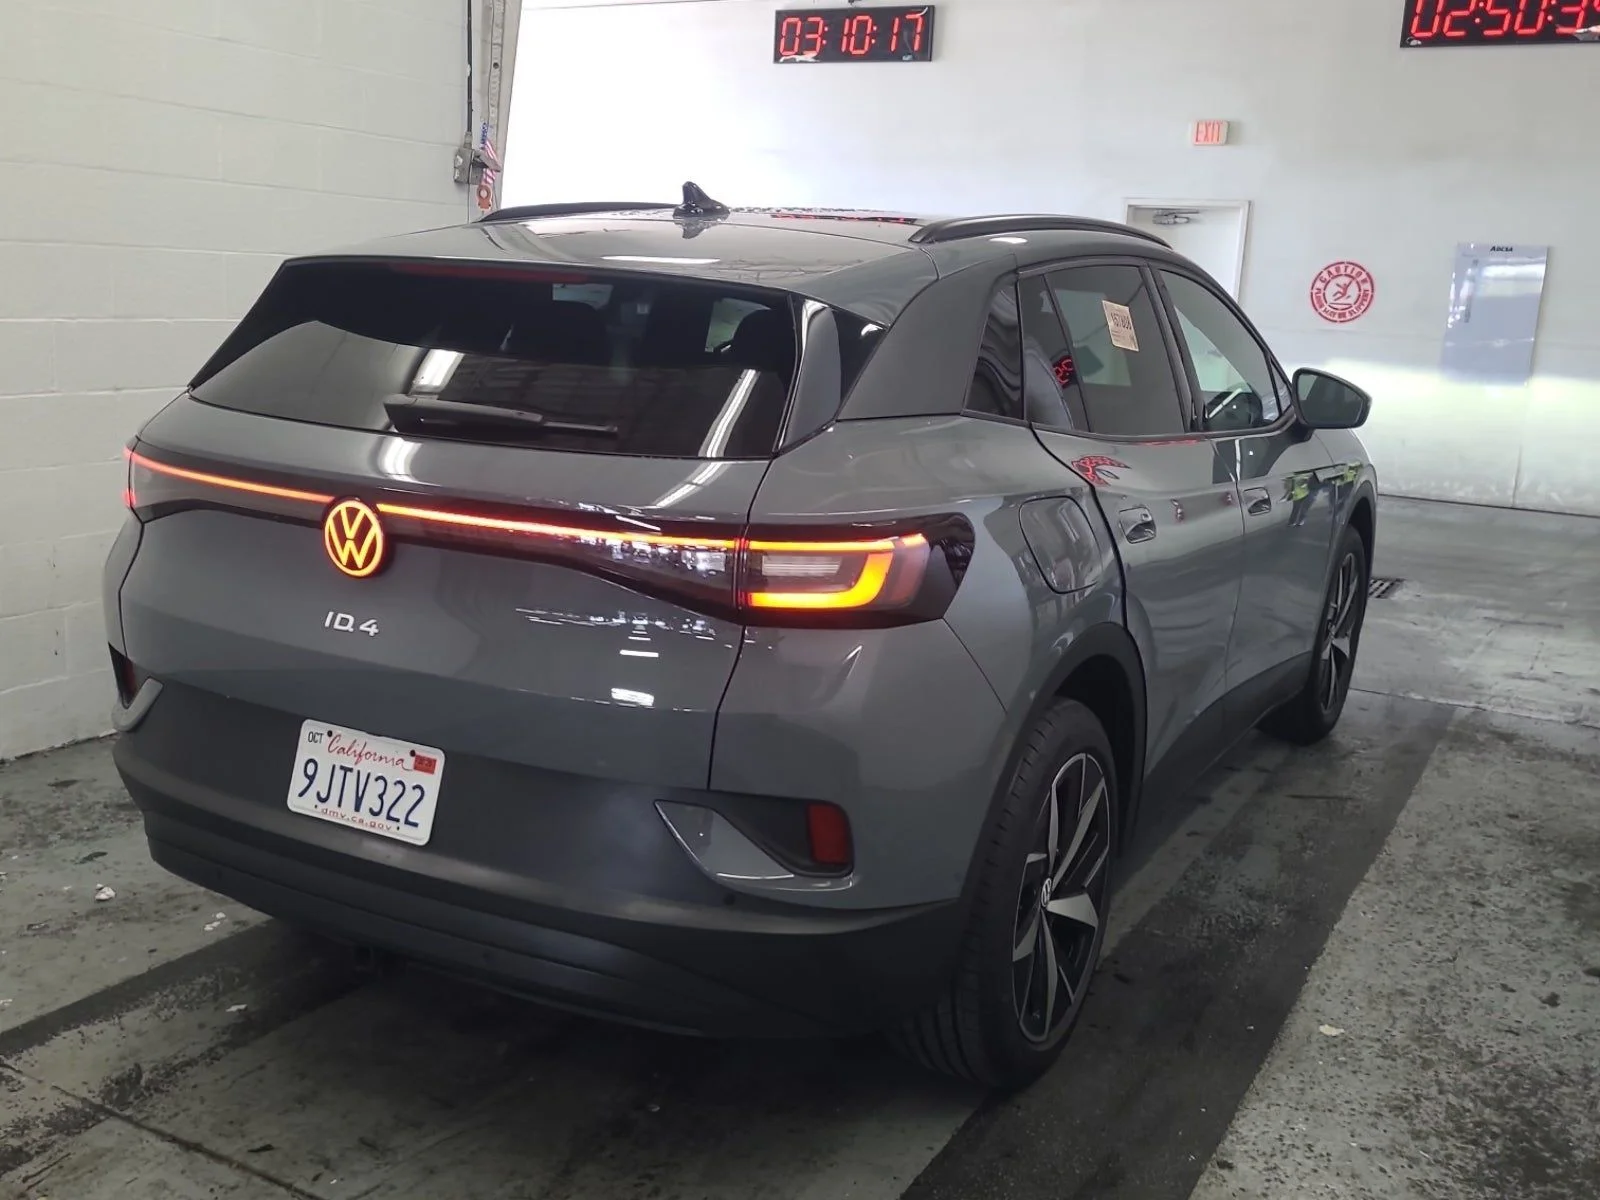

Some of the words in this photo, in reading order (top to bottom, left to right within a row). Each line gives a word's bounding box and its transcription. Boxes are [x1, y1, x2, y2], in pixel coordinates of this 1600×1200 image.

[1410, 0, 1600, 38] 02:50:3
[779, 14, 924, 56] 03:10:17
[1195, 120, 1223, 143] EXIT
[1319, 265, 1368, 284] CAUTION
[307, 731, 324, 745] OCT
[327, 733, 413, 772] California
[297, 758, 426, 828] 9JTV322
[321, 807, 393, 832] dmv.ca.gov
